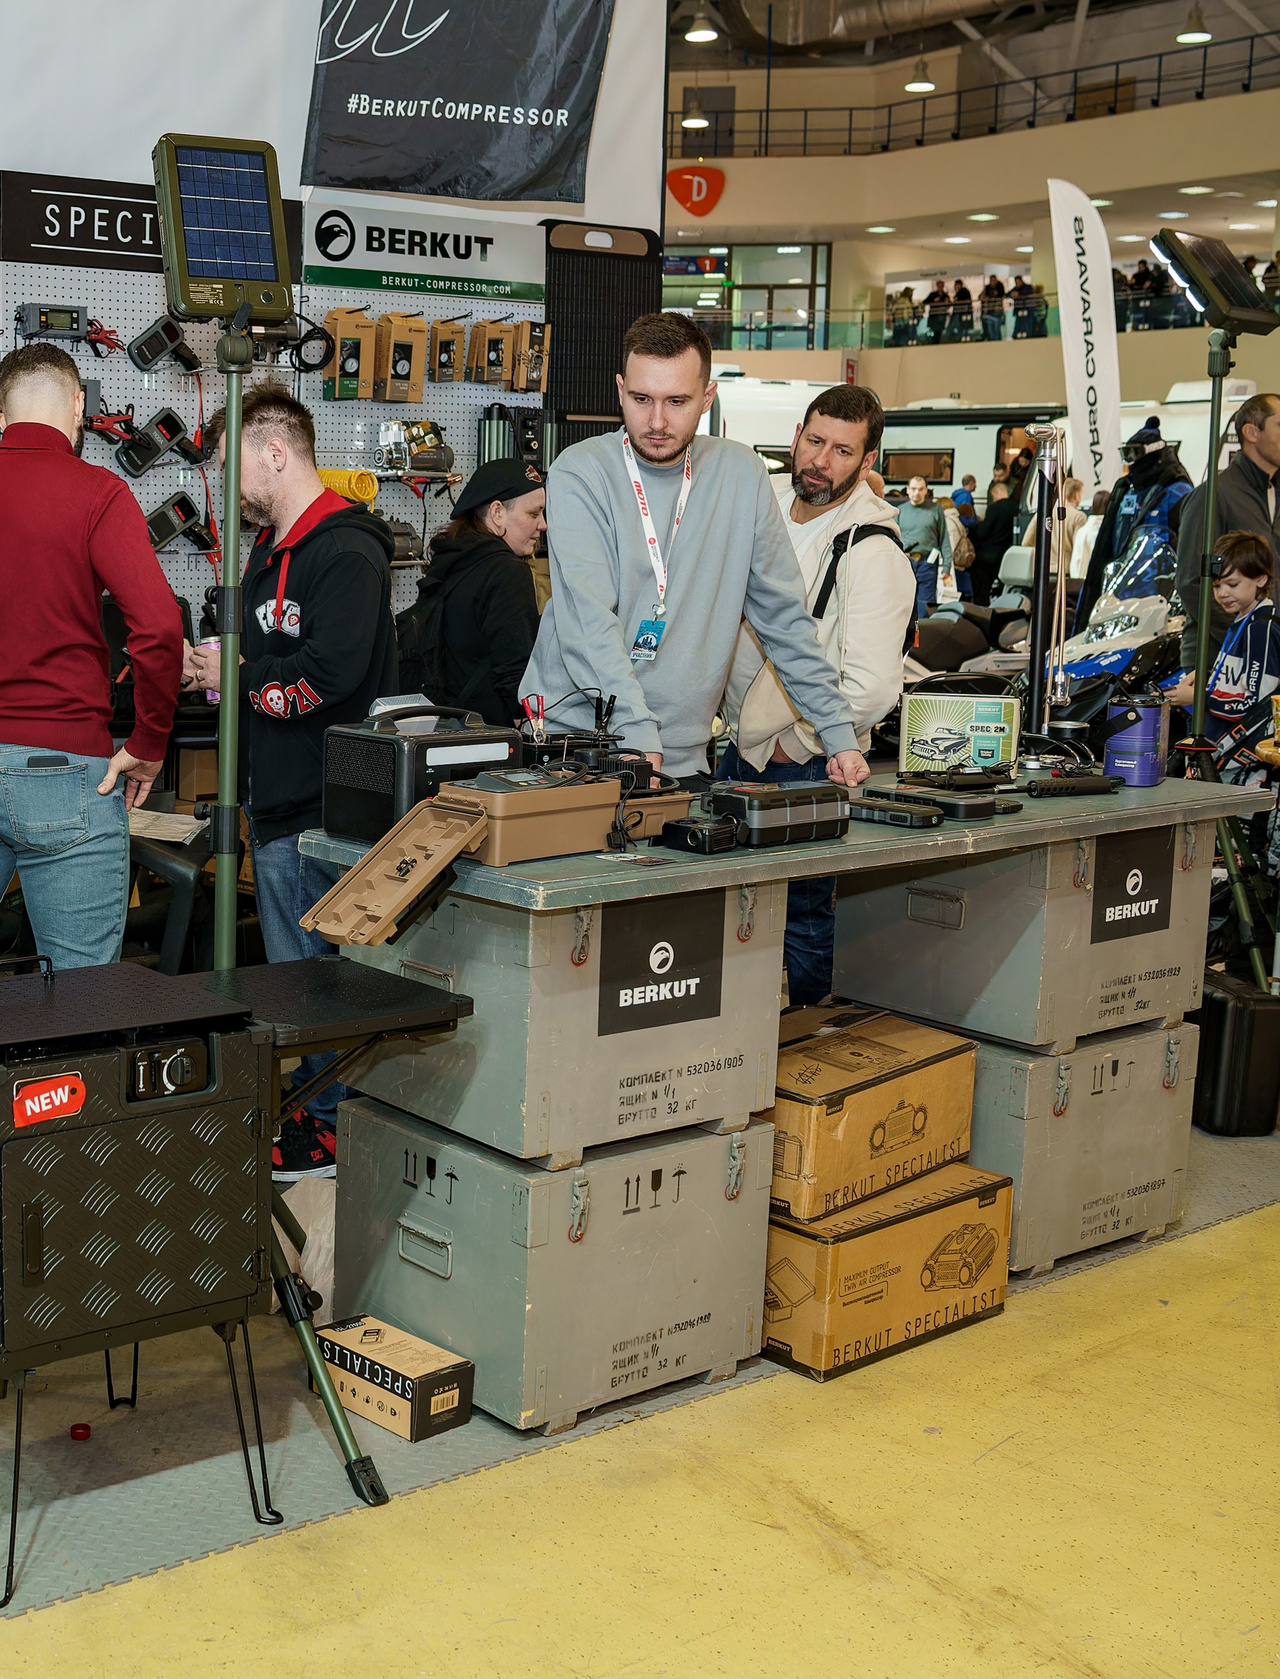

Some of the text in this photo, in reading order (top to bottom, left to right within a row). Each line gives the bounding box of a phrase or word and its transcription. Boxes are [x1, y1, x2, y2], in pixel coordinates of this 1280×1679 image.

[691, 175, 708, 202] D
[44, 203, 154, 245] SPECI
[365, 225, 494, 262] BERKUT
[381, 275, 511, 295] BERKUT-COMPRESSOR.COM
[970, 725, 991, 733] SPEC
[1105, 898, 1159, 923] BERKUT
[619, 977, 701, 1008] BERKUT
[619, 1068, 674, 1089] КОМПЛЕКТ
[25, 1084, 70, 1117] NEW
[618, 1091, 648, 1108] ЯЩИК
[618, 1107, 658, 1126] БРУТТО
[666, 1100, 679, 1115] 32
[824, 1136, 964, 1212] BERKUT SPECIALIST
[822, 1174, 997, 1236] BERKUT SPECIALIST
[869, 1260, 890, 1276] OUTPUT
[869, 1265, 902, 1283] COMPRESSOR
[612, 1328, 665, 1355] КОМПЛЕКТ
[832, 1288, 998, 1368] BERKUT SPECIALIST
[317, 1337, 414, 1400] SPECIALIS
[610, 1354, 688, 1388] БРУТТО 32 КГ
[612, 1354, 640, 1371] ЯЩИК
